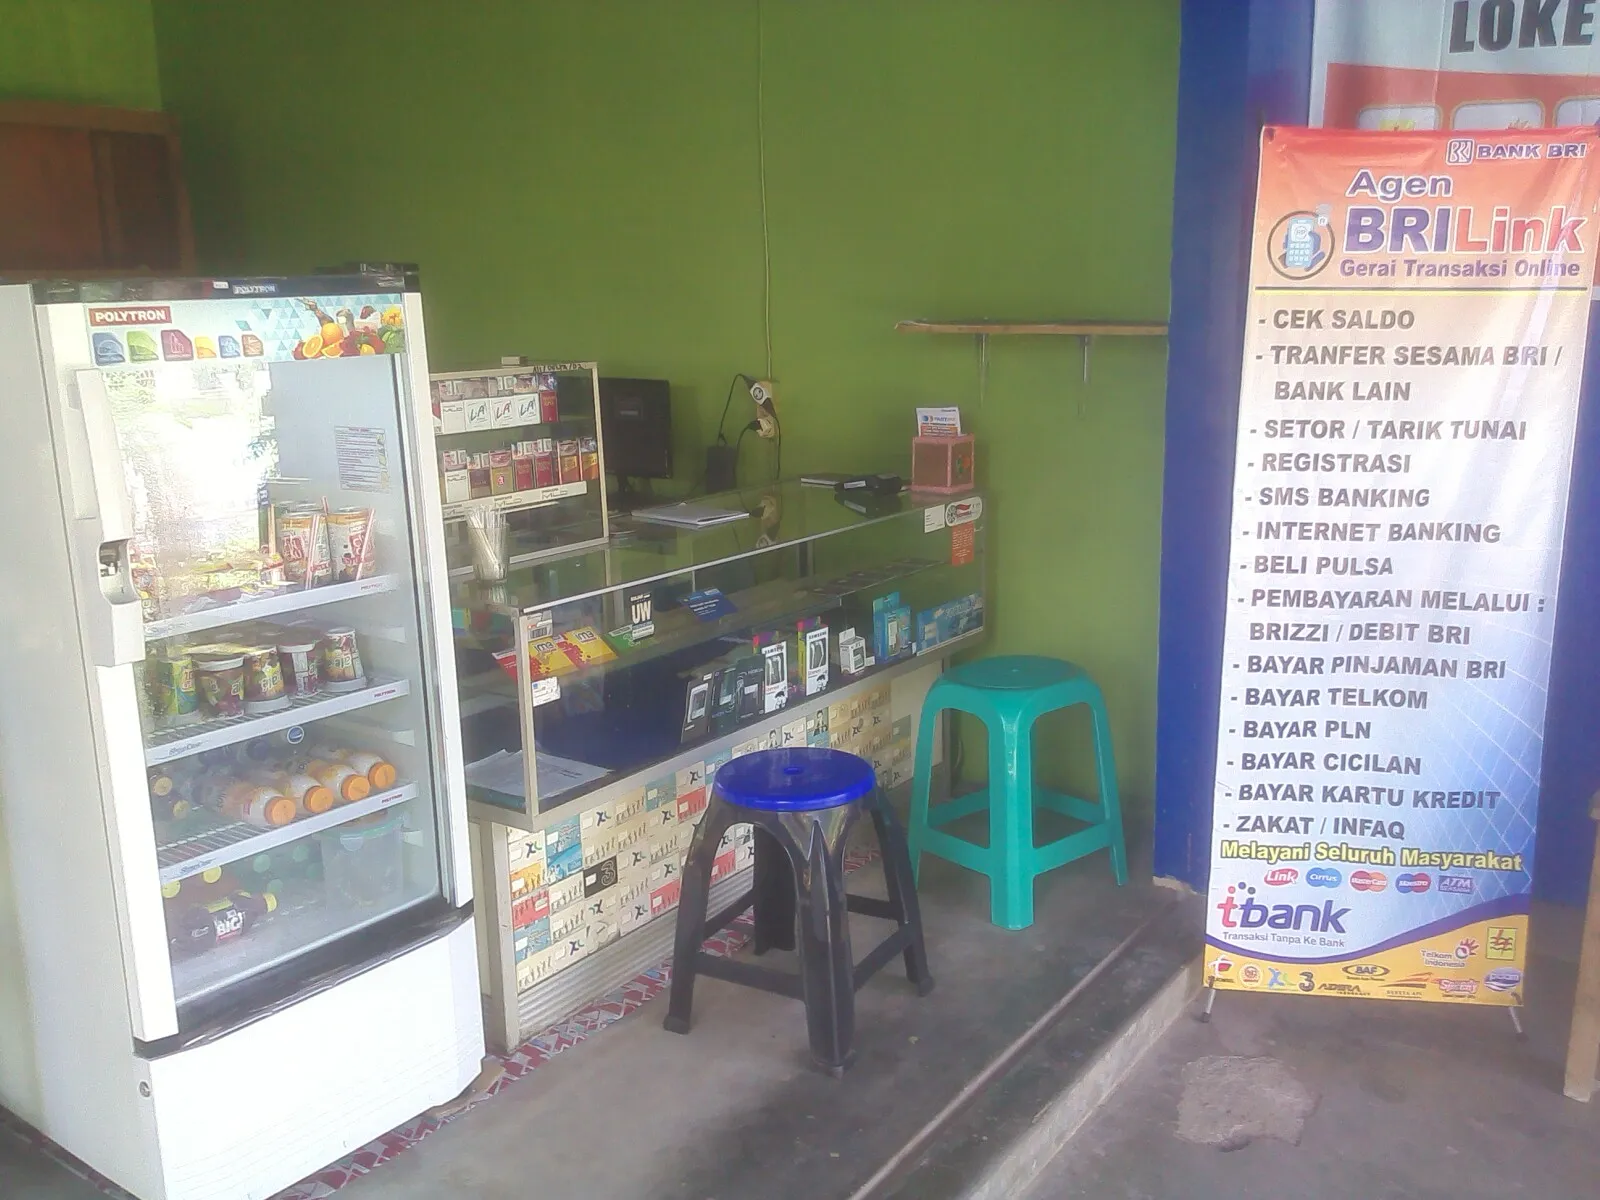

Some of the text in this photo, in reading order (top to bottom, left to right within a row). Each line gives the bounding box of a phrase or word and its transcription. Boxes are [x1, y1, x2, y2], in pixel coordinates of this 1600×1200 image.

[1477, 145, 1539, 159] BANK
[1547, 143, 1587, 158] BRI
[1347, 171, 1452, 201] Agen
[1344, 206, 1586, 254] BRILink
[1340, 260, 1580, 277] Gerai Transaksi Online
[95, 310, 167, 323] POLYTRON
[1273, 310, 1323, 329] CEK
[1332, 310, 1415, 329] SALDO
[1270, 346, 1385, 365] TRANFER
[1393, 346, 1494, 365] SESAMA
[1502, 346, 1547, 365] BRI
[1274, 382, 1411, 401] BANK LAIN
[1264, 420, 1345, 439] SETOR
[1368, 421, 1443, 439] TARIK
[1452, 421, 1526, 440] TUNAI
[1262, 453, 1410, 473] REGISTRASI
[1259, 488, 1309, 506] SMS
[1318, 488, 1430, 507] BANKING
[1256, 522, 1381, 541] INTERNET
[1388, 523, 1501, 543] BANKING
[1254, 556, 1307, 574] BELI
[1316, 557, 1393, 576] PULSA
[1251, 590, 1412, 609] PEMBAYARAN
[1420, 591, 1529, 612] MELALUI
[1250, 623, 1328, 642] BRIZZI
[1349, 623, 1419, 642] DEBIT
[1428, 625, 1470, 645] BRI
[1248, 656, 1324, 675] BAYAR
[1331, 656, 1457, 678] PINJAMAN
[1466, 661, 1506, 679] BRI
[1245, 688, 1320, 706] BAYAR
[1328, 688, 1428, 709] TELKOM
[1243, 721, 1317, 738] BAYAR
[1325, 721, 1371, 739] PLN
[1242, 753, 1315, 770] BAYAR
[1324, 754, 1421, 775] CICILAN
[1239, 785, 1313, 802] BAYAR
[1322, 785, 1404, 806] KARTU
[1412, 790, 1501, 809] KREDIT
[1236, 816, 1314, 834] ZAKAT
[1333, 818, 1405, 840] INFAQ
[525, 841, 542, 859] XL
[1221, 840, 1522, 871] Melayani Seluruh Masyarakat
[601, 860, 616, 886] 3
[1442, 876, 1471, 887] ATM
[1223, 932, 1345, 947] Transaksi Tanpa Ke Bank
[1421, 951, 1452, 959] Telkom
[1425, 959, 1465, 967] Indonesia
